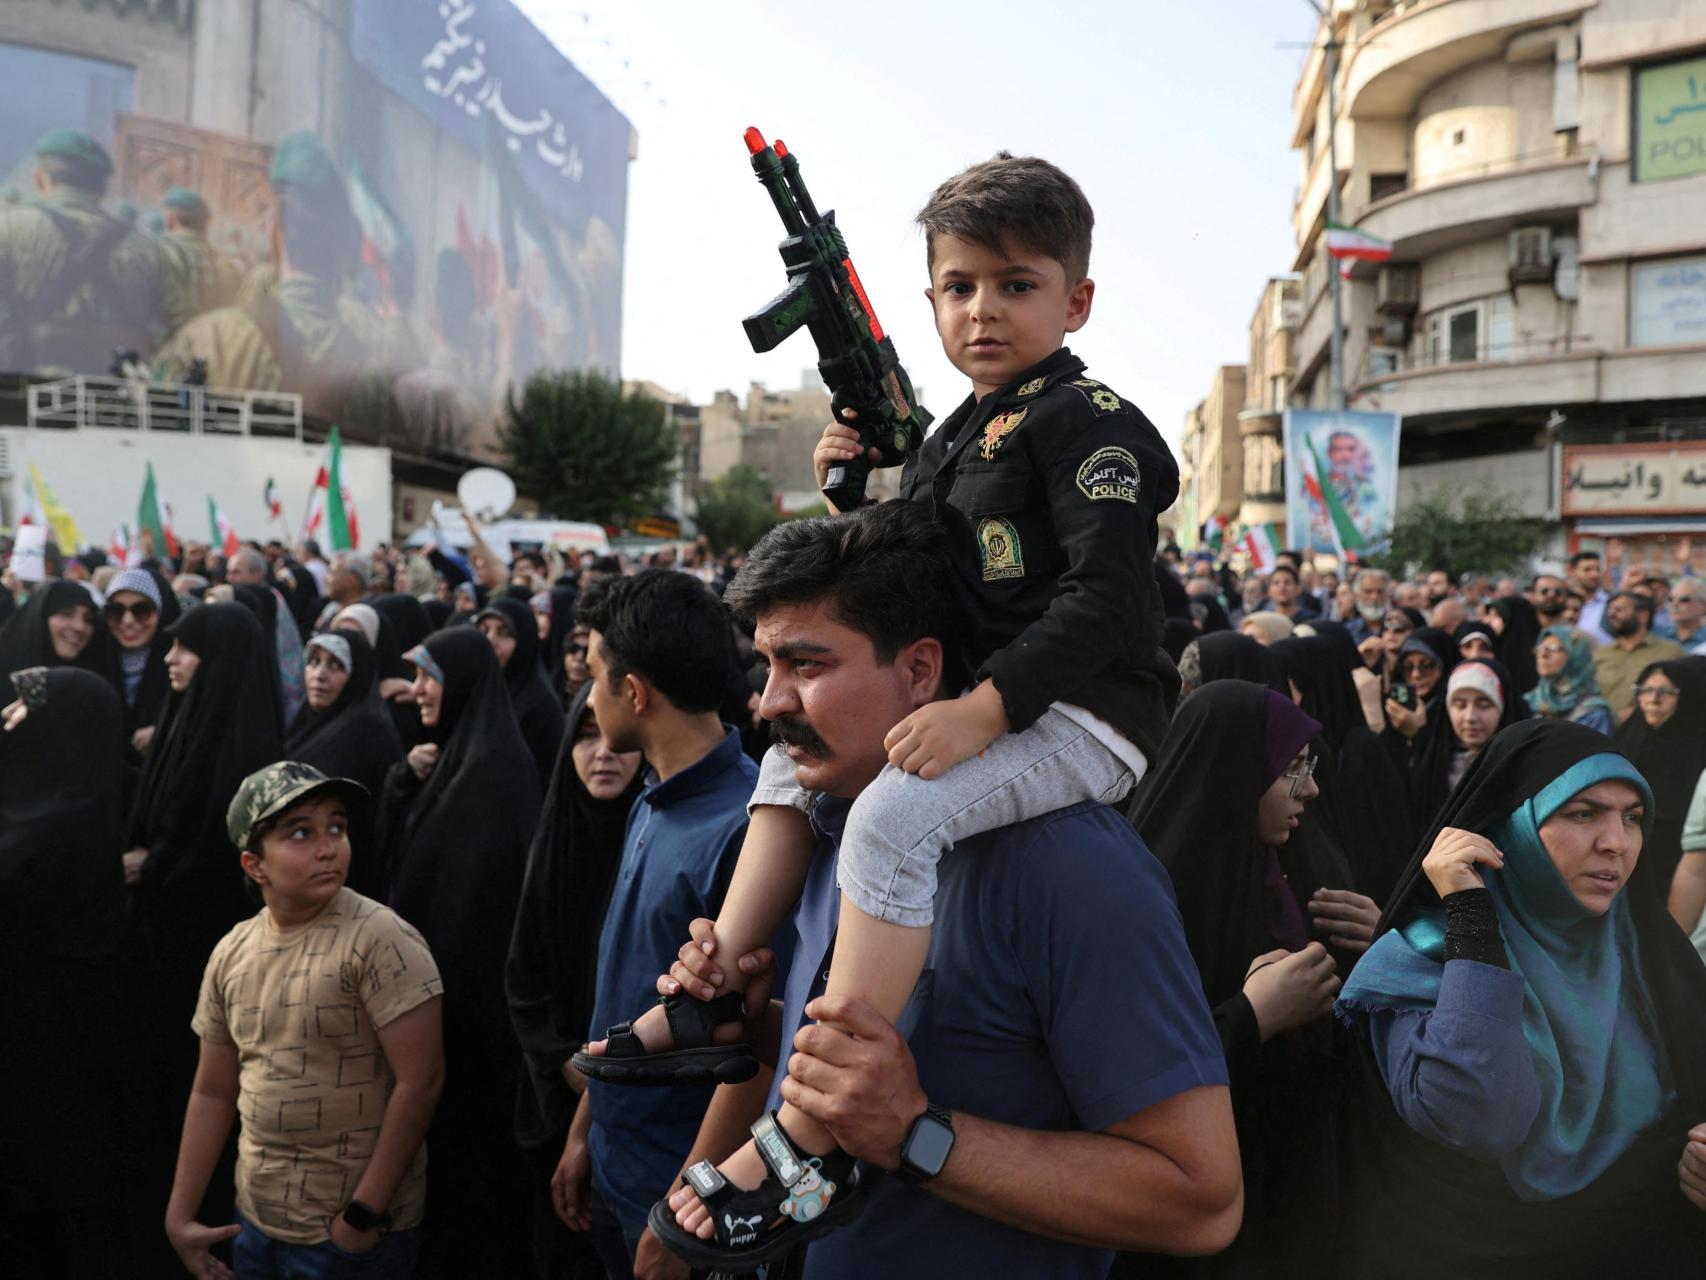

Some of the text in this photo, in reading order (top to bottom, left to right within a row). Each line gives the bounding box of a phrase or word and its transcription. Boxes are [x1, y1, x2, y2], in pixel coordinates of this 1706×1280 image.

[1084, 467, 1119, 486] آگاهی
[1568, 461, 1663, 500] وانیلا
[1092, 484, 1137, 500] POLICE
[730, 1231, 758, 1247] puppy
